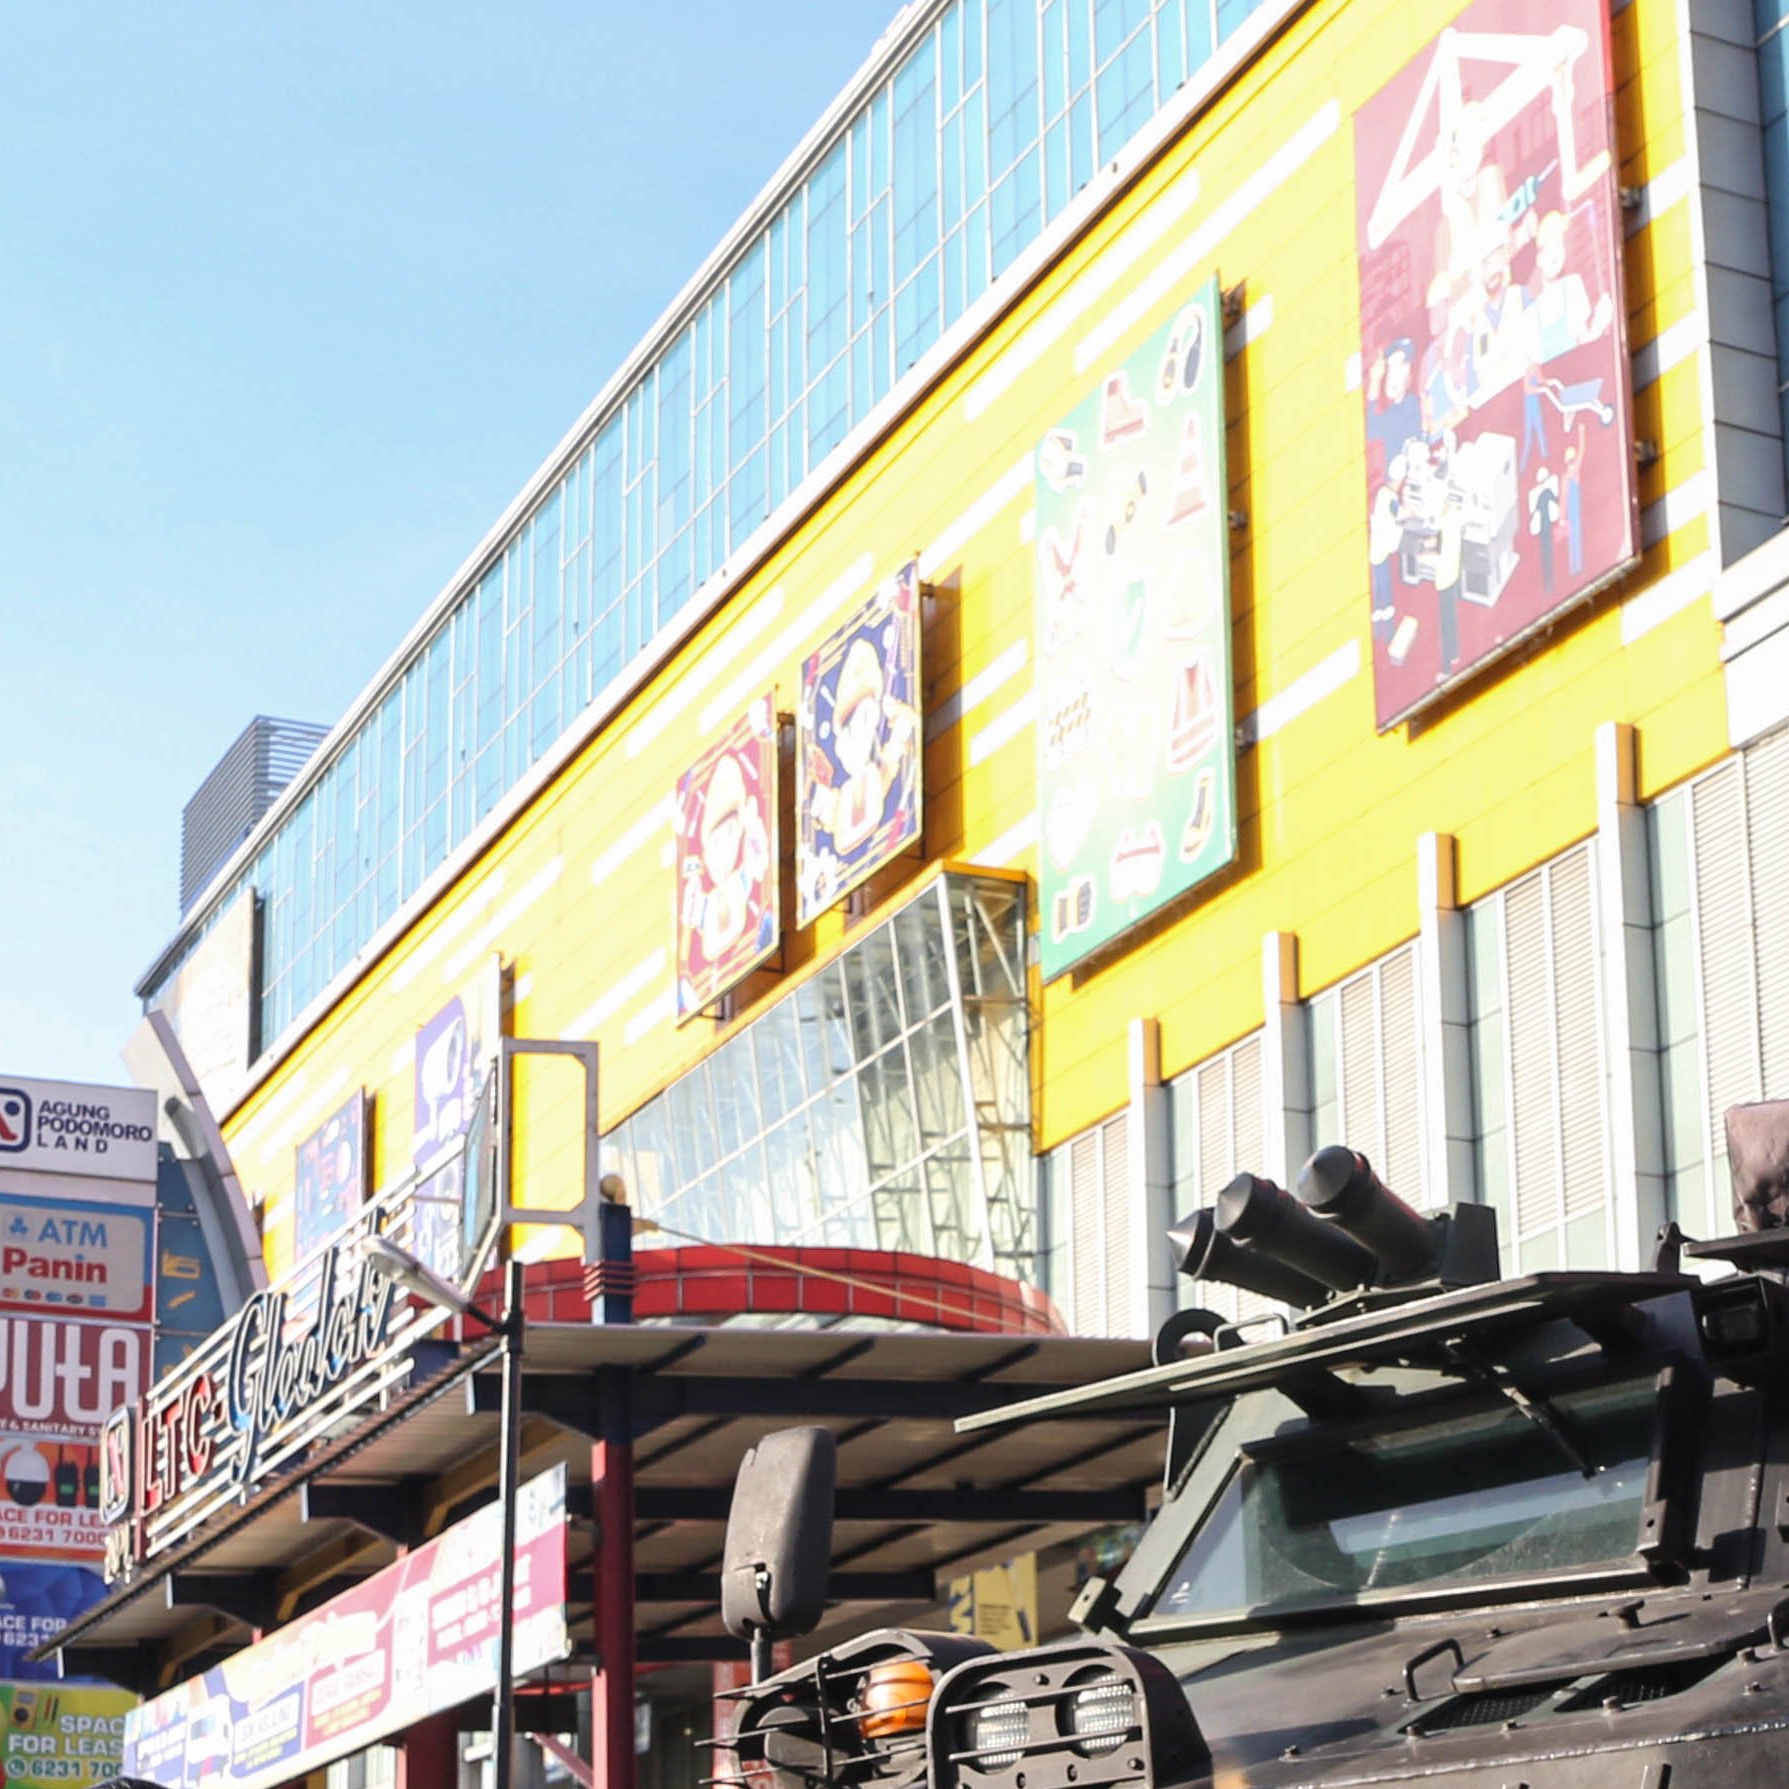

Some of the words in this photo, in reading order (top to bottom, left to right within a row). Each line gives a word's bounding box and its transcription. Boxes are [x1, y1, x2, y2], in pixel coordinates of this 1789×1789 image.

[38, 1100, 110, 1120] AGUNG
[37, 1114, 152, 1142] PODOMORO
[37, 1135, 108, 1153] LAND
[38, 1217, 108, 1248] ATM
[2, 1247, 108, 1283] Panin
[35, 1509, 73, 1527] FOR
[8, 1526, 54, 1543] 6231
[8, 1733, 56, 1754] FOR
[31, 1757, 82, 1778] 6231
